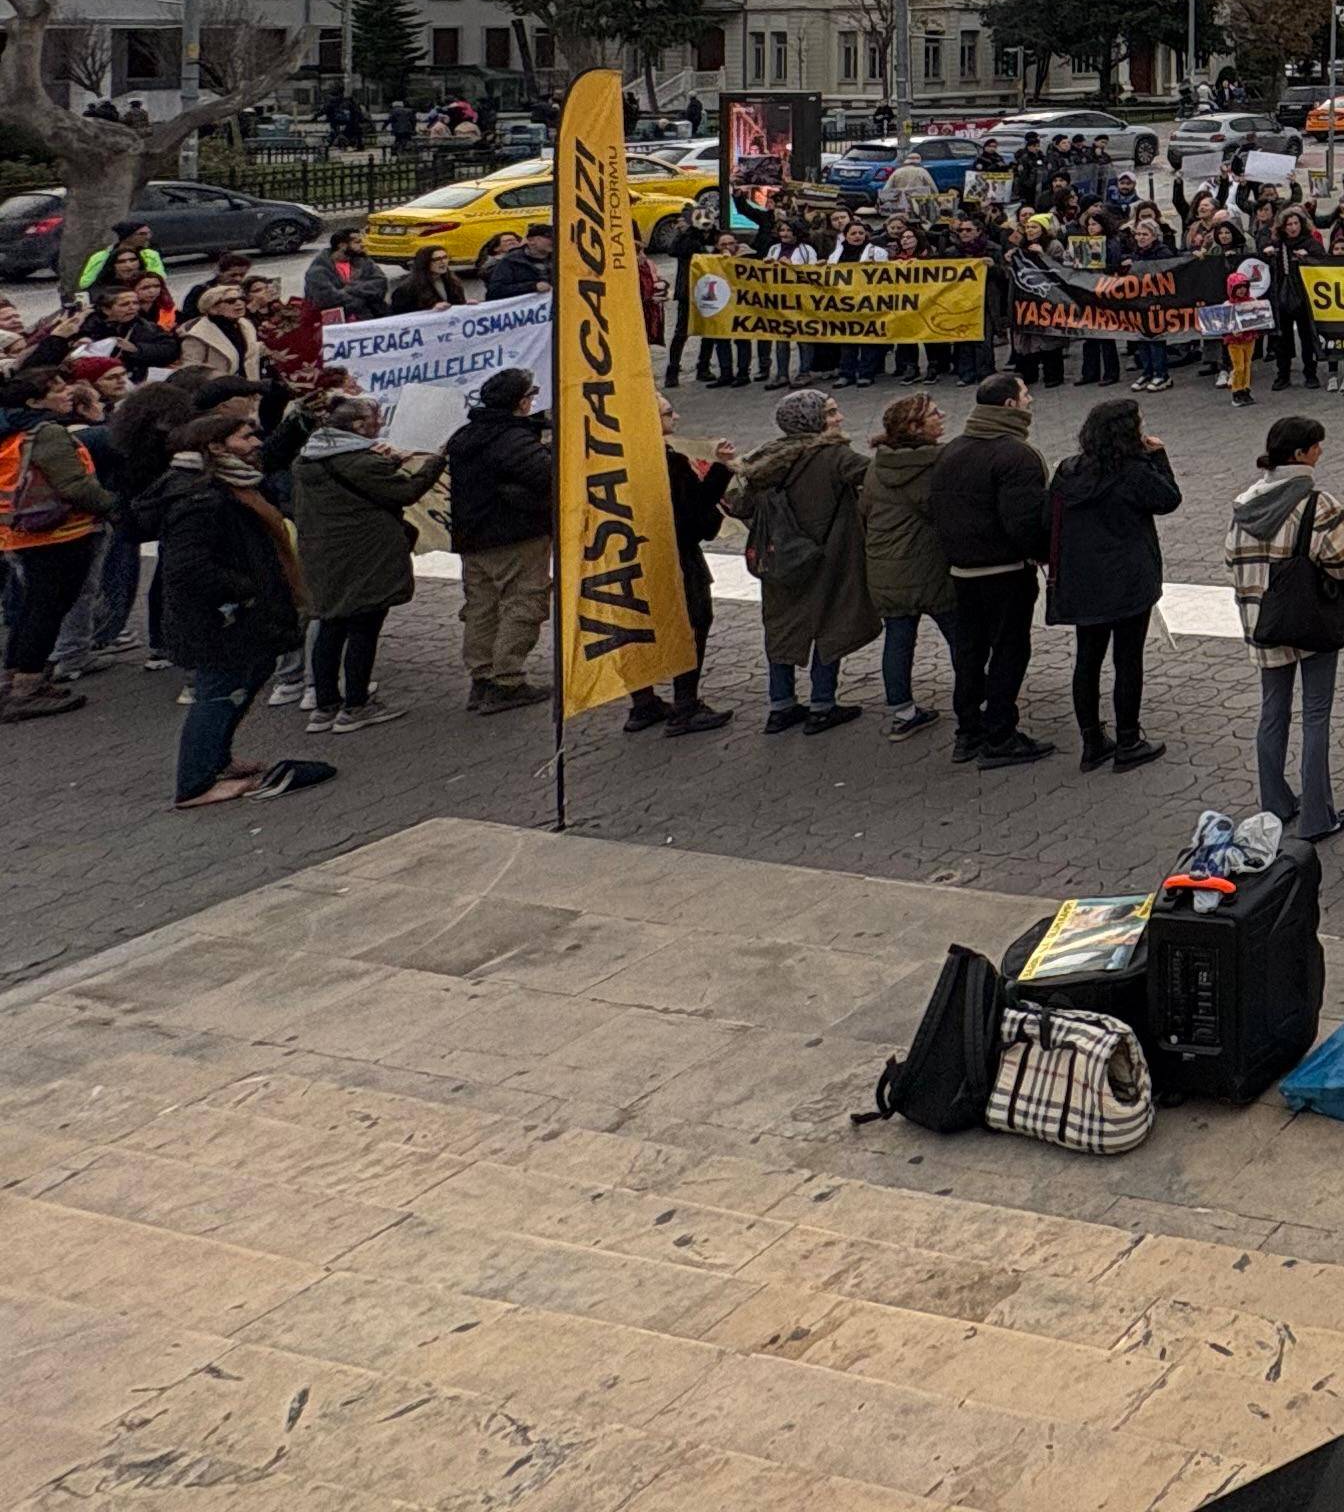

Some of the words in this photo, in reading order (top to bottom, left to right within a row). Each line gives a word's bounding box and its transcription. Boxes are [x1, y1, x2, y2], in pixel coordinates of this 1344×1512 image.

[606, 145, 627, 271] PLATFORMU
[734, 263, 854, 287] PATİLERİN
[862, 265, 978, 285] YANINDA
[736, 289, 801, 311] KANLI
[810, 292, 920, 312] YASANIN
[731, 315, 887, 338] KARŞISINDA!
[569, 136, 656, 662] YAŞATACAĞIZ!
